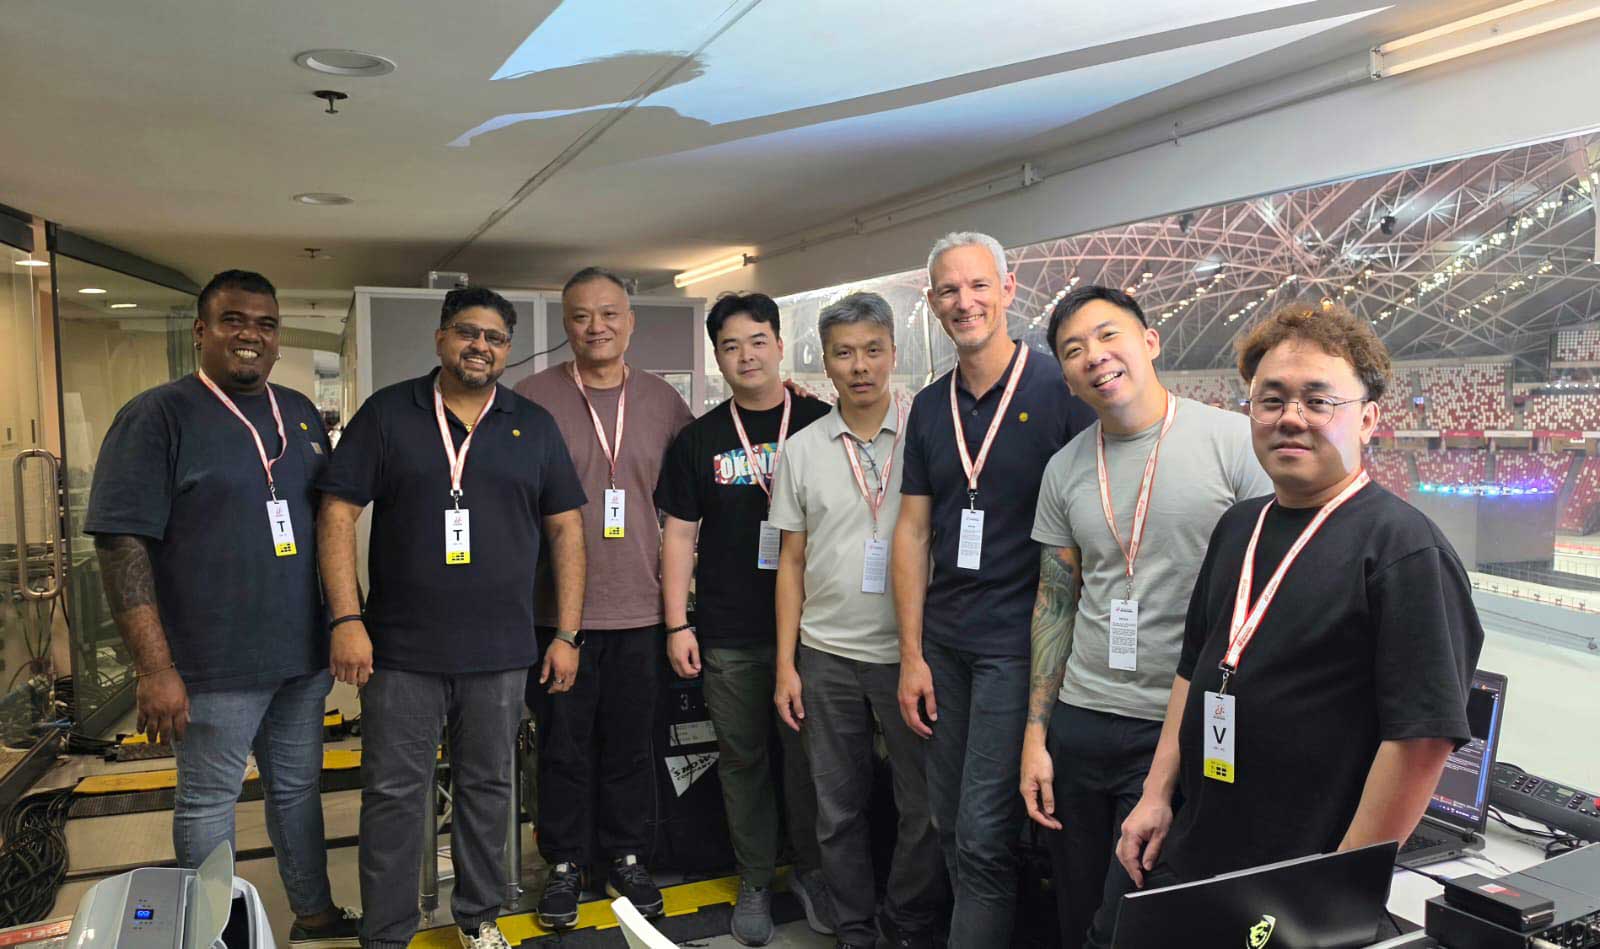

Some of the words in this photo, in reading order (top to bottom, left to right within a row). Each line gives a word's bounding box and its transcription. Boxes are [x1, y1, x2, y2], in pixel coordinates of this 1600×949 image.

[610, 506, 620, 518] T
[276, 520, 285, 532] T
[452, 529, 463, 541] T
[1212, 725, 1227, 745] V
